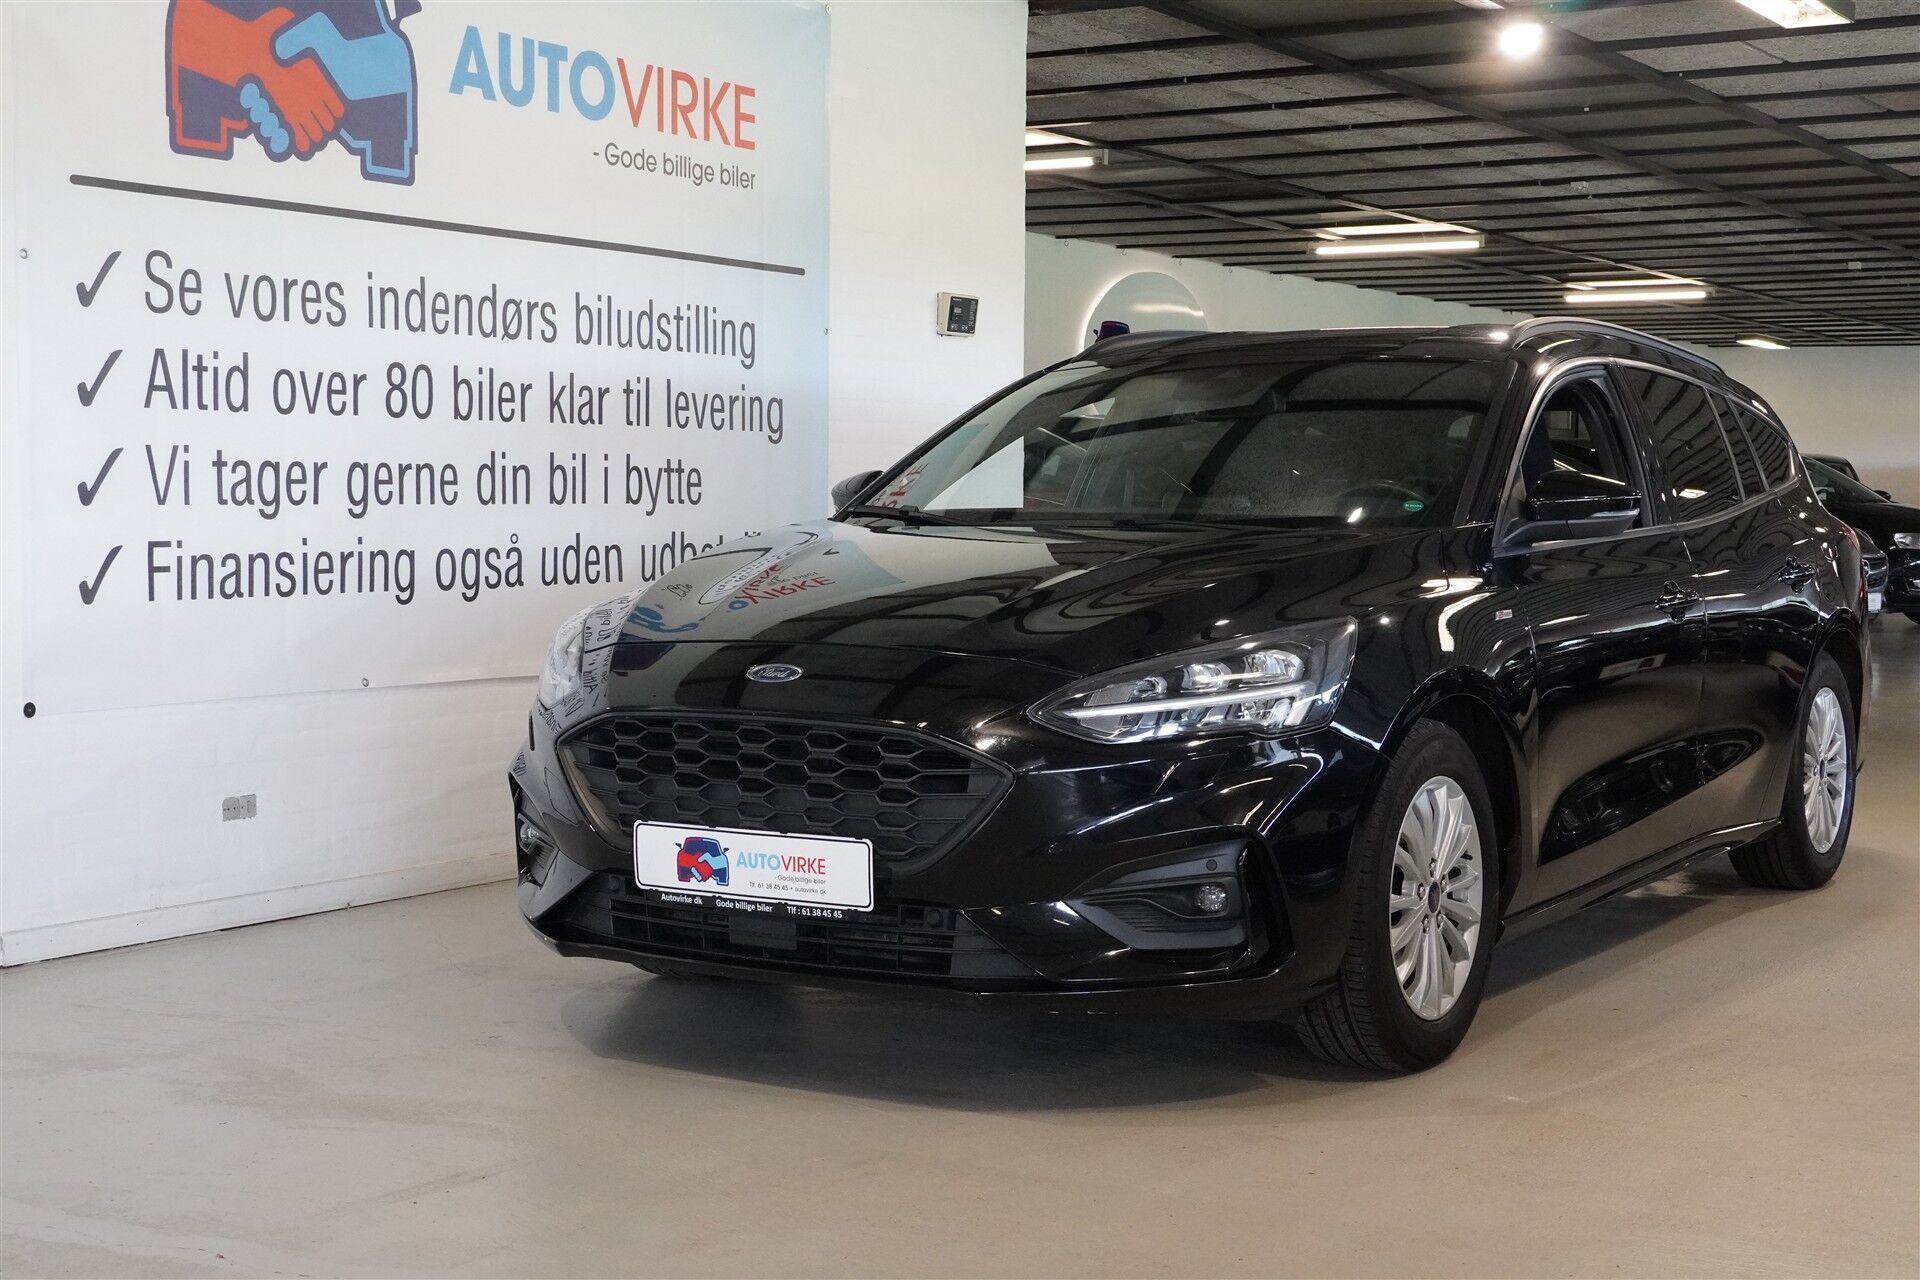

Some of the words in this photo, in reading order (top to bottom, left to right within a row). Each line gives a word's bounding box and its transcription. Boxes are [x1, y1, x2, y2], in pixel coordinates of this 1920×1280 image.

[450, 25, 757, 151] AUTOVIRKE
[604, 142, 657, 173] Gode
[662, 152, 715, 187] billige
[720, 163, 756, 190] biler
[144, 249, 202, 316] Se
[225, 272, 347, 327] vores
[367, 271, 558, 345] indendørs
[575, 291, 757, 370] biludstilling
[143, 348, 249, 413] Altid
[272, 368, 368, 417] over
[385, 361, 434, 420] 80
[453, 364, 533, 422] biler
[549, 371, 610, 426] klar
[622, 376, 650, 427] til
[666, 378, 785, 445] levering
[145, 444, 190, 507] Vi
[211, 449, 328, 520] tager
[346, 461, 459, 520] gerne
[476, 450, 531, 506] din
[549, 451, 587, 506] bil
[603, 453, 609, 505] i
[625, 453, 702, 517] bytte
[147, 536, 416, 606] Finansiering
[435, 532, 525, 603] også
[541, 532, 624, 587] uden
[736, 851, 826, 875] AUTOVIRKE
[777, 874, 794, 882] Gode
[795, 876, 813, 885] billige
[661, 892, 693, 904] Autovirke
[716, 899, 734, 909] Gode
[735, 900, 756, 912] billige
[757, 903, 773, 913] biler
[801, 908, 812, 916] 61
[812, 909, 822, 917] 38
[822, 909, 832, 918] 45
[832, 910, 843, 919] 45
